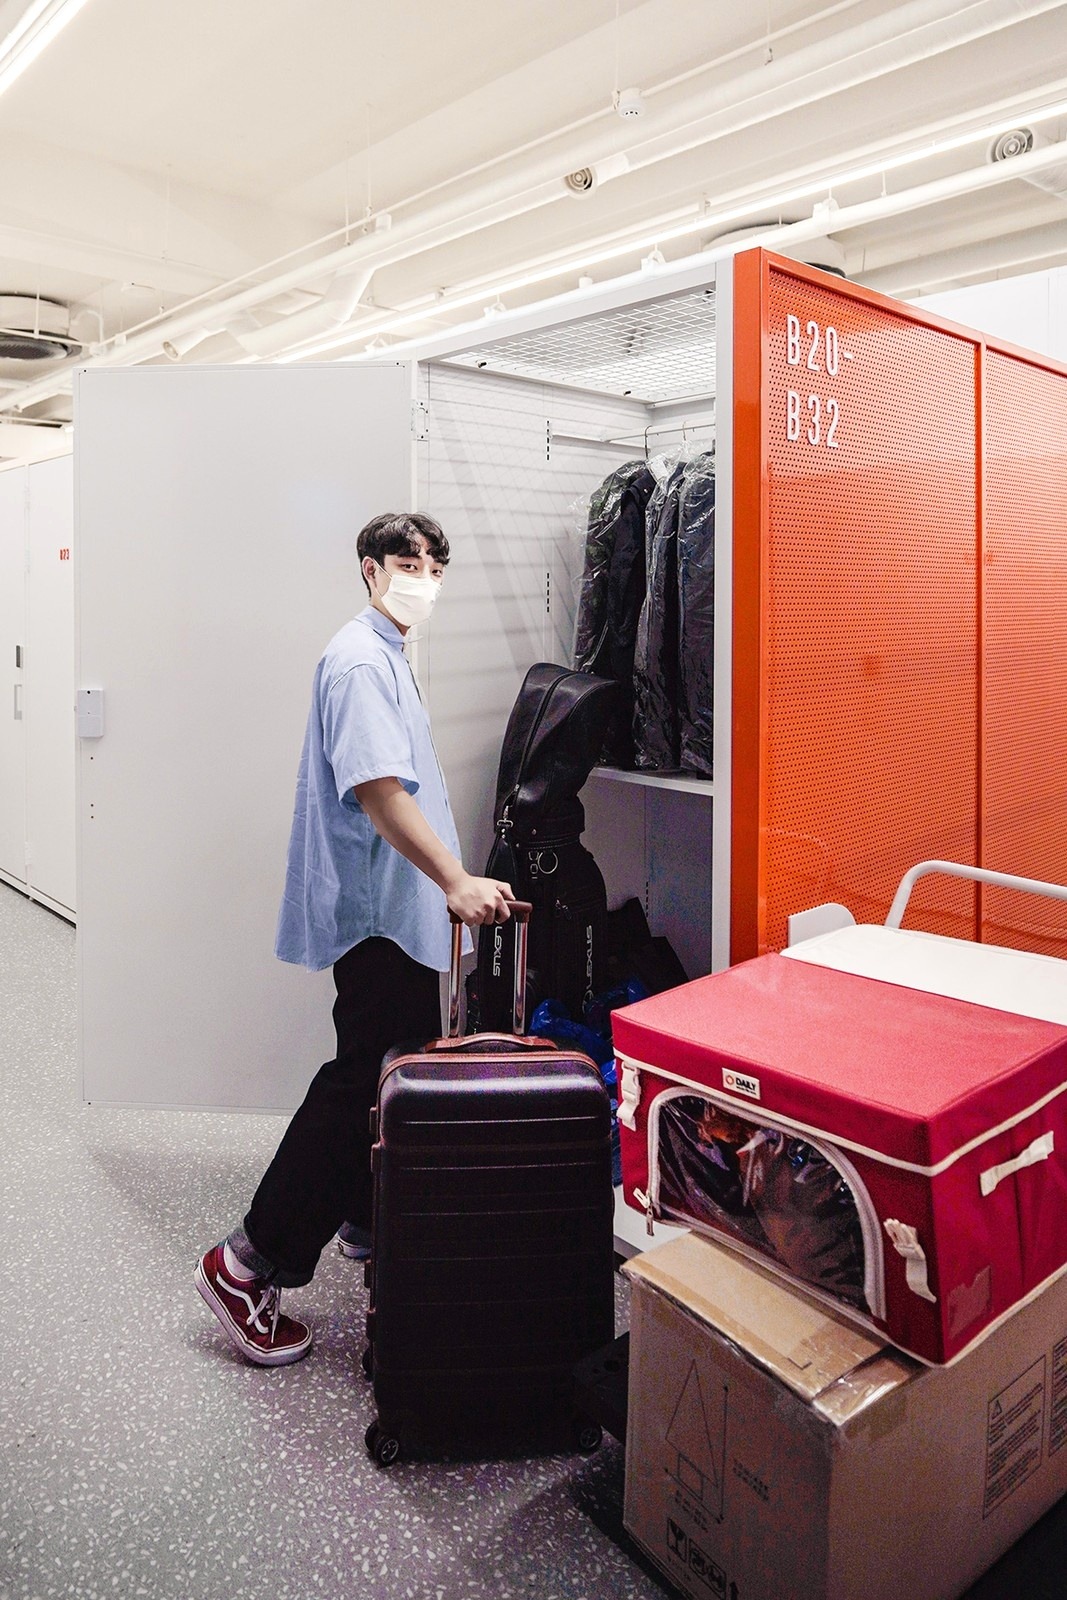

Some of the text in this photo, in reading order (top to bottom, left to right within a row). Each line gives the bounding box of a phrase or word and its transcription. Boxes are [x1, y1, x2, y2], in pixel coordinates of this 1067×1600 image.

[787, 314, 853, 376] B20-
[786, 390, 839, 449] B32
[493, 926, 502, 976] LEXUS
[735, 1077, 756, 1091] DAILY
